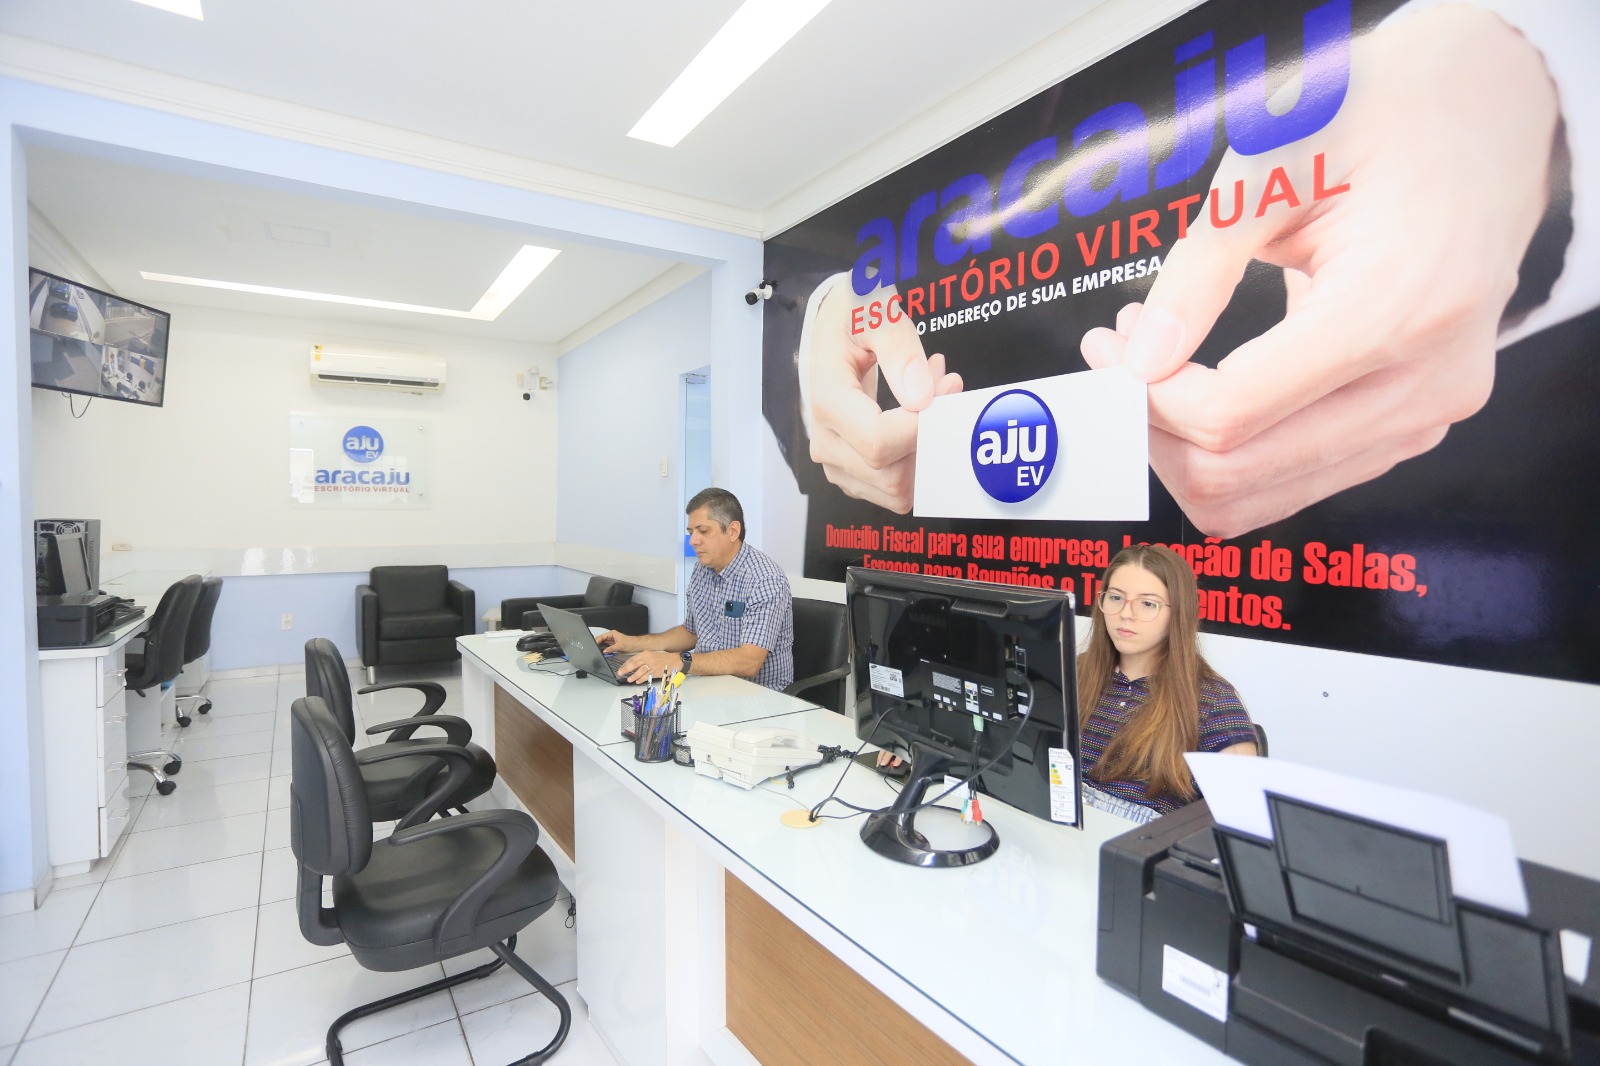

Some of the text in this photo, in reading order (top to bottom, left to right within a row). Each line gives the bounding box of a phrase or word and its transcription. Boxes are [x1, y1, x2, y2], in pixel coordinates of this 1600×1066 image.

[851, 0, 1352, 296] aracaju
[851, 152, 1351, 336] ESCRITÓRIO VIRTUAL
[930, 299, 1002, 333] ENDEREÇO
[1006, 292, 1027, 312] DE
[1031, 282, 1067, 304] SUA
[1072, 255, 1163, 295] EMPRESA
[345, 435, 380, 451] aju
[365, 450, 380, 459] EV
[976, 419, 1047, 466] aju
[314, 468, 411, 486] aracaju
[373, 486, 411, 494] VIRTUAL
[1017, 465, 1045, 487] EV
[883, 526, 924, 554] Fiscal
[927, 532, 968, 559] para
[971, 534, 1005, 560] sua
[1250, 539, 1293, 582] de
[1303, 541, 1428, 598] Salas,
